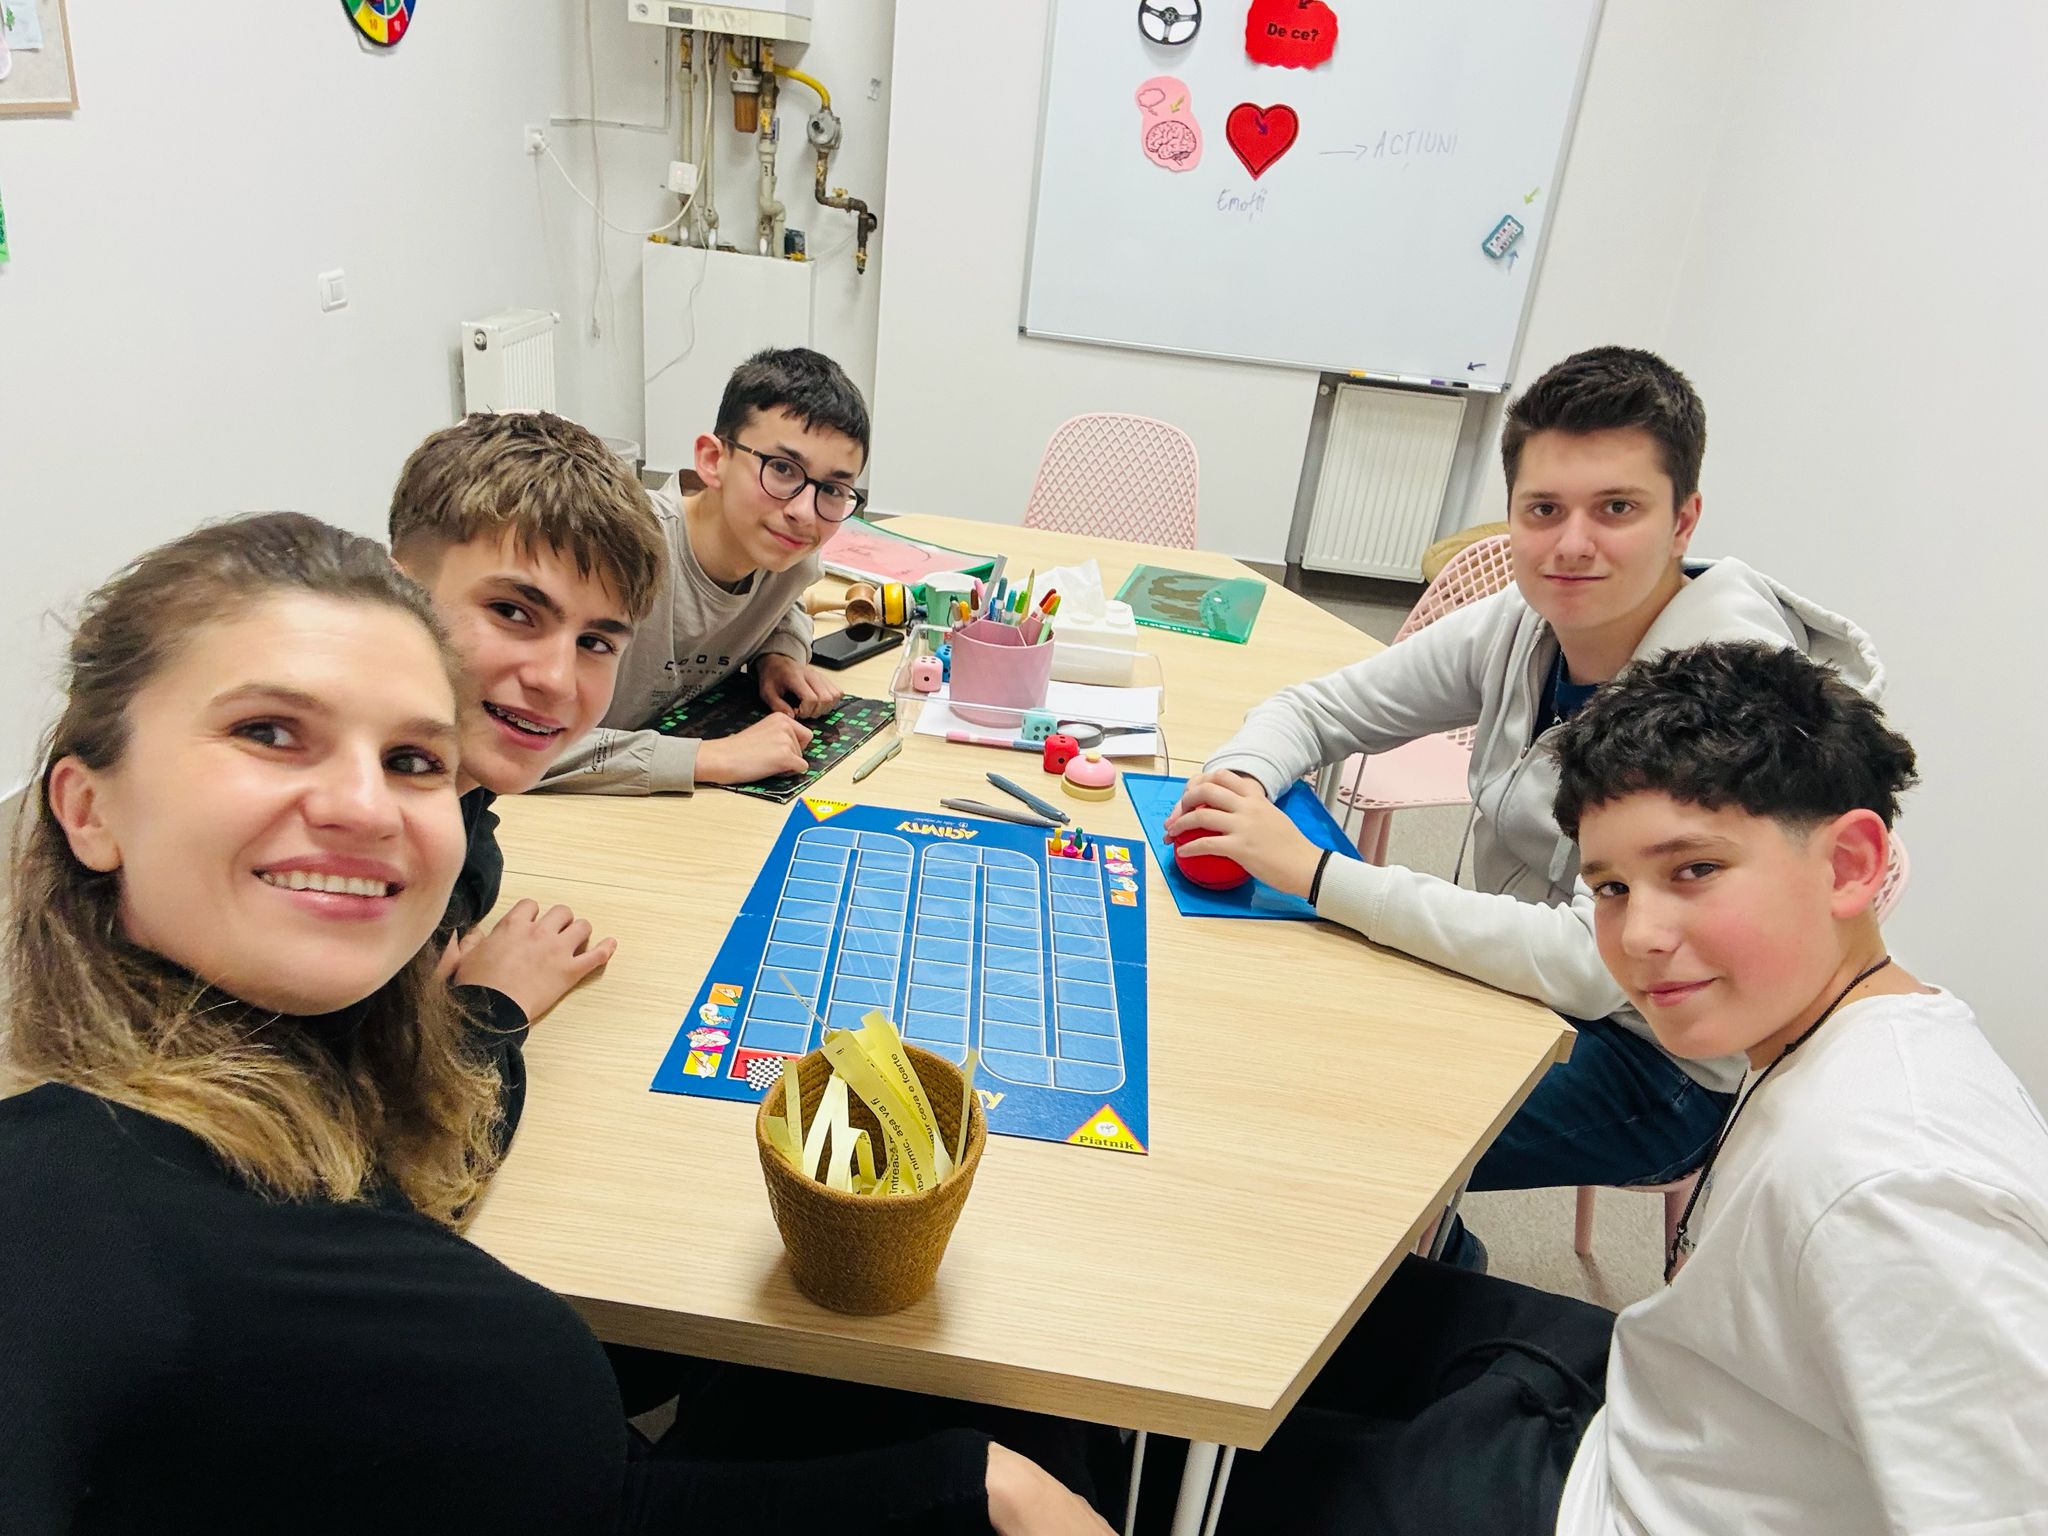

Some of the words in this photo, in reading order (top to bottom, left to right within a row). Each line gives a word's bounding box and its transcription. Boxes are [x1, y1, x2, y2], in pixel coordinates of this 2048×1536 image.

[1266, 22, 1287, 38] De
[1290, 28, 1319, 42] ce?
[895, 820, 980, 840] ACTIVITY
[891, 1053, 911, 1084] foarte
[870, 1097, 881, 1106] fi
[878, 1105, 890, 1118] va
[912, 1095, 927, 1121] ceva
[1079, 1135, 1135, 1150] Piatnik
